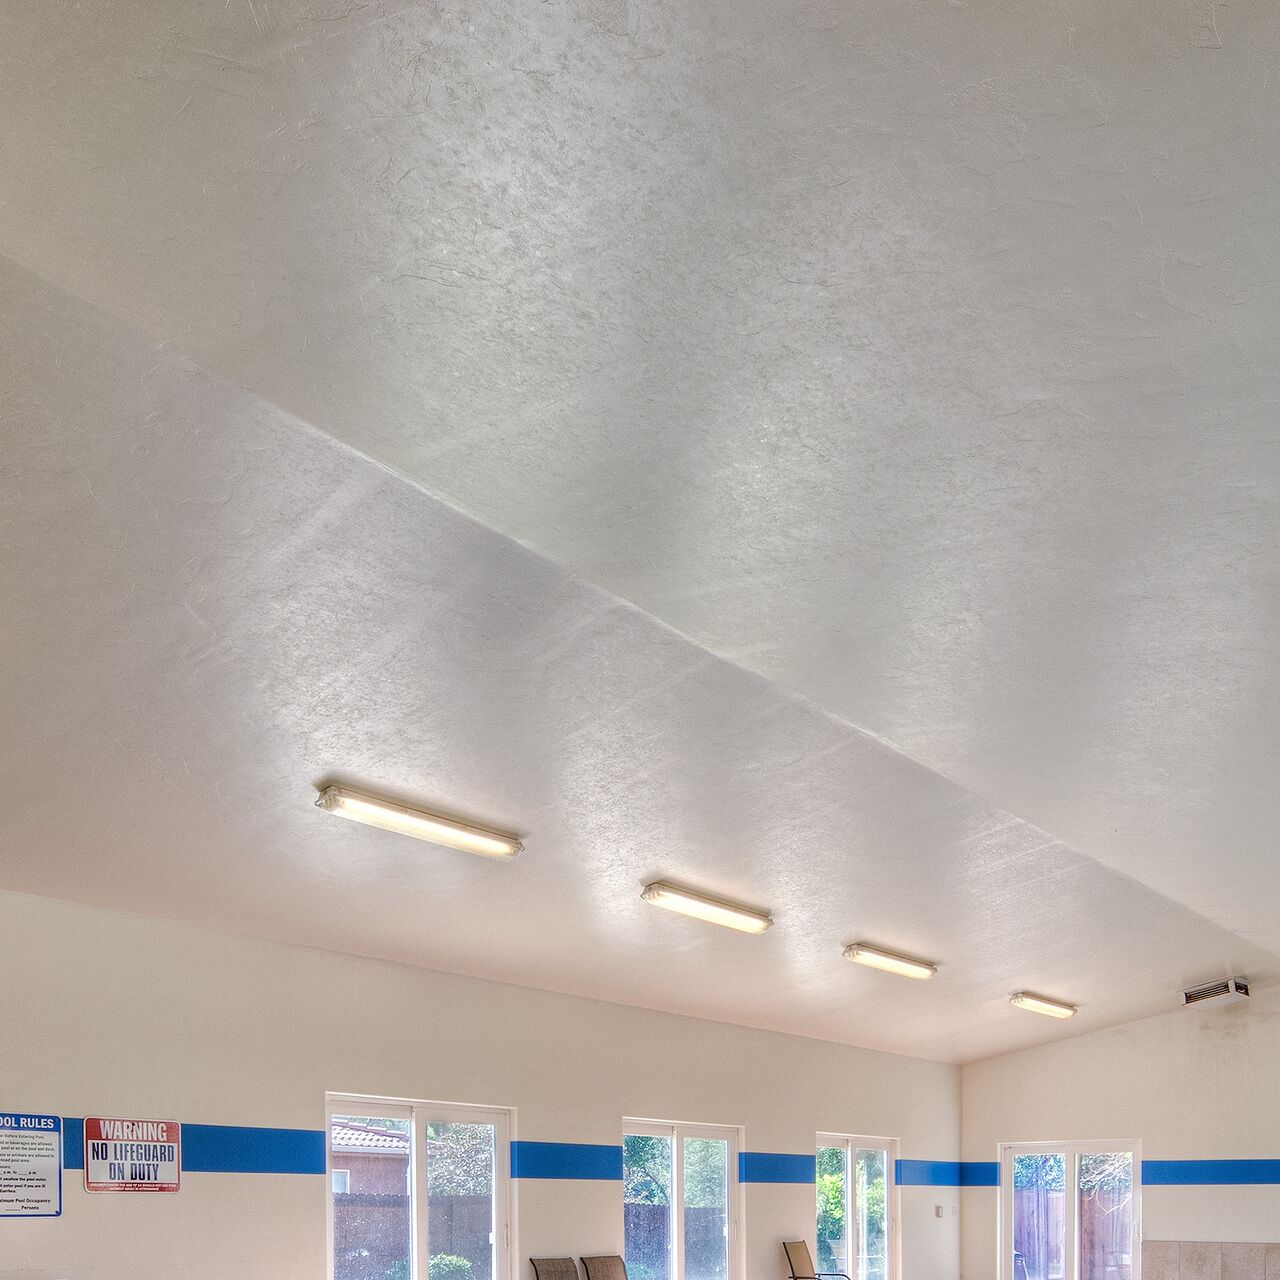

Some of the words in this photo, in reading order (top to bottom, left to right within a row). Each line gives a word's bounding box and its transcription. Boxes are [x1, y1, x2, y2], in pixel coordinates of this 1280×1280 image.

[20, 1118, 54, 1128] RULES
[100, 1120, 167, 1141] WARNING
[92, 1143, 107, 1160] NO
[114, 1144, 174, 1162] LIFEGUARD
[110, 1163, 124, 1180] ON
[131, 1163, 158, 1180] DUTY
